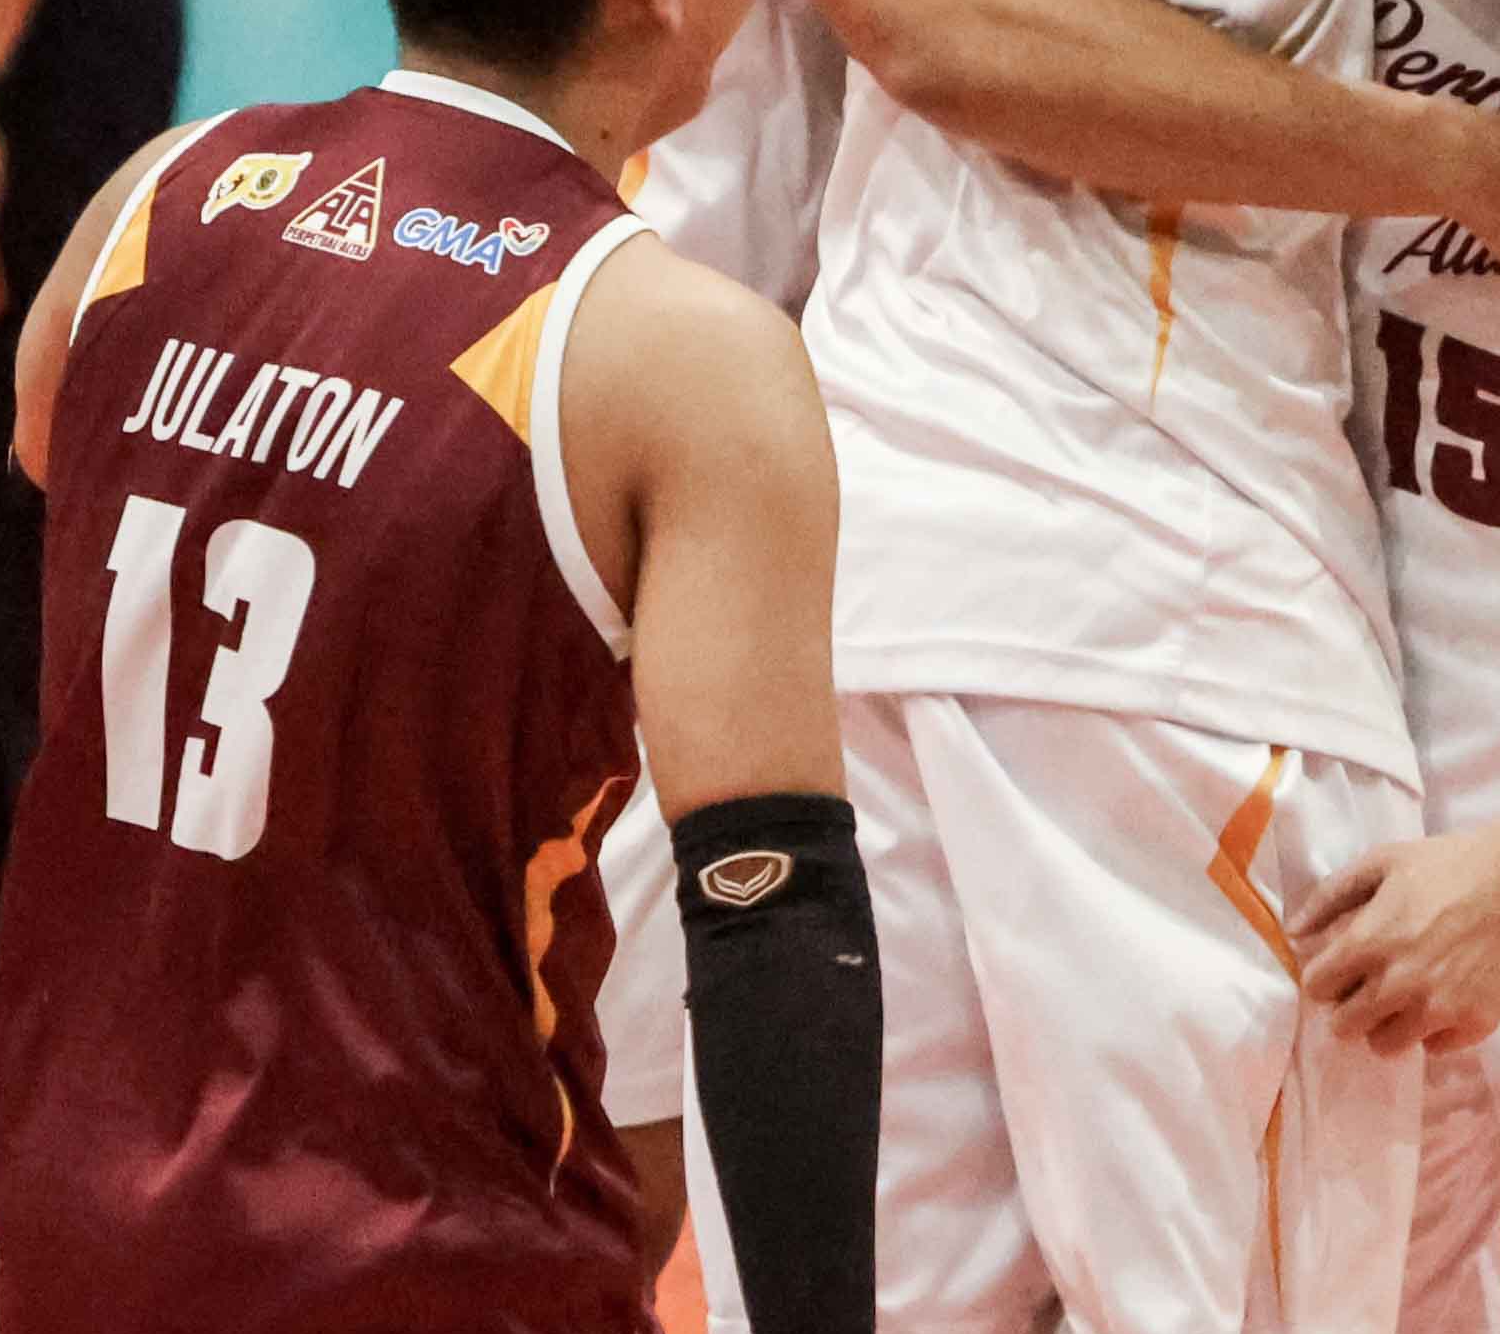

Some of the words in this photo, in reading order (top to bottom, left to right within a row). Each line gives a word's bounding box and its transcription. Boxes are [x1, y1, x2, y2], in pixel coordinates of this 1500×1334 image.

[394, 207, 503, 275] GMA
[122, 338, 404, 489] JULATON
[102, 494, 316, 861] 13
